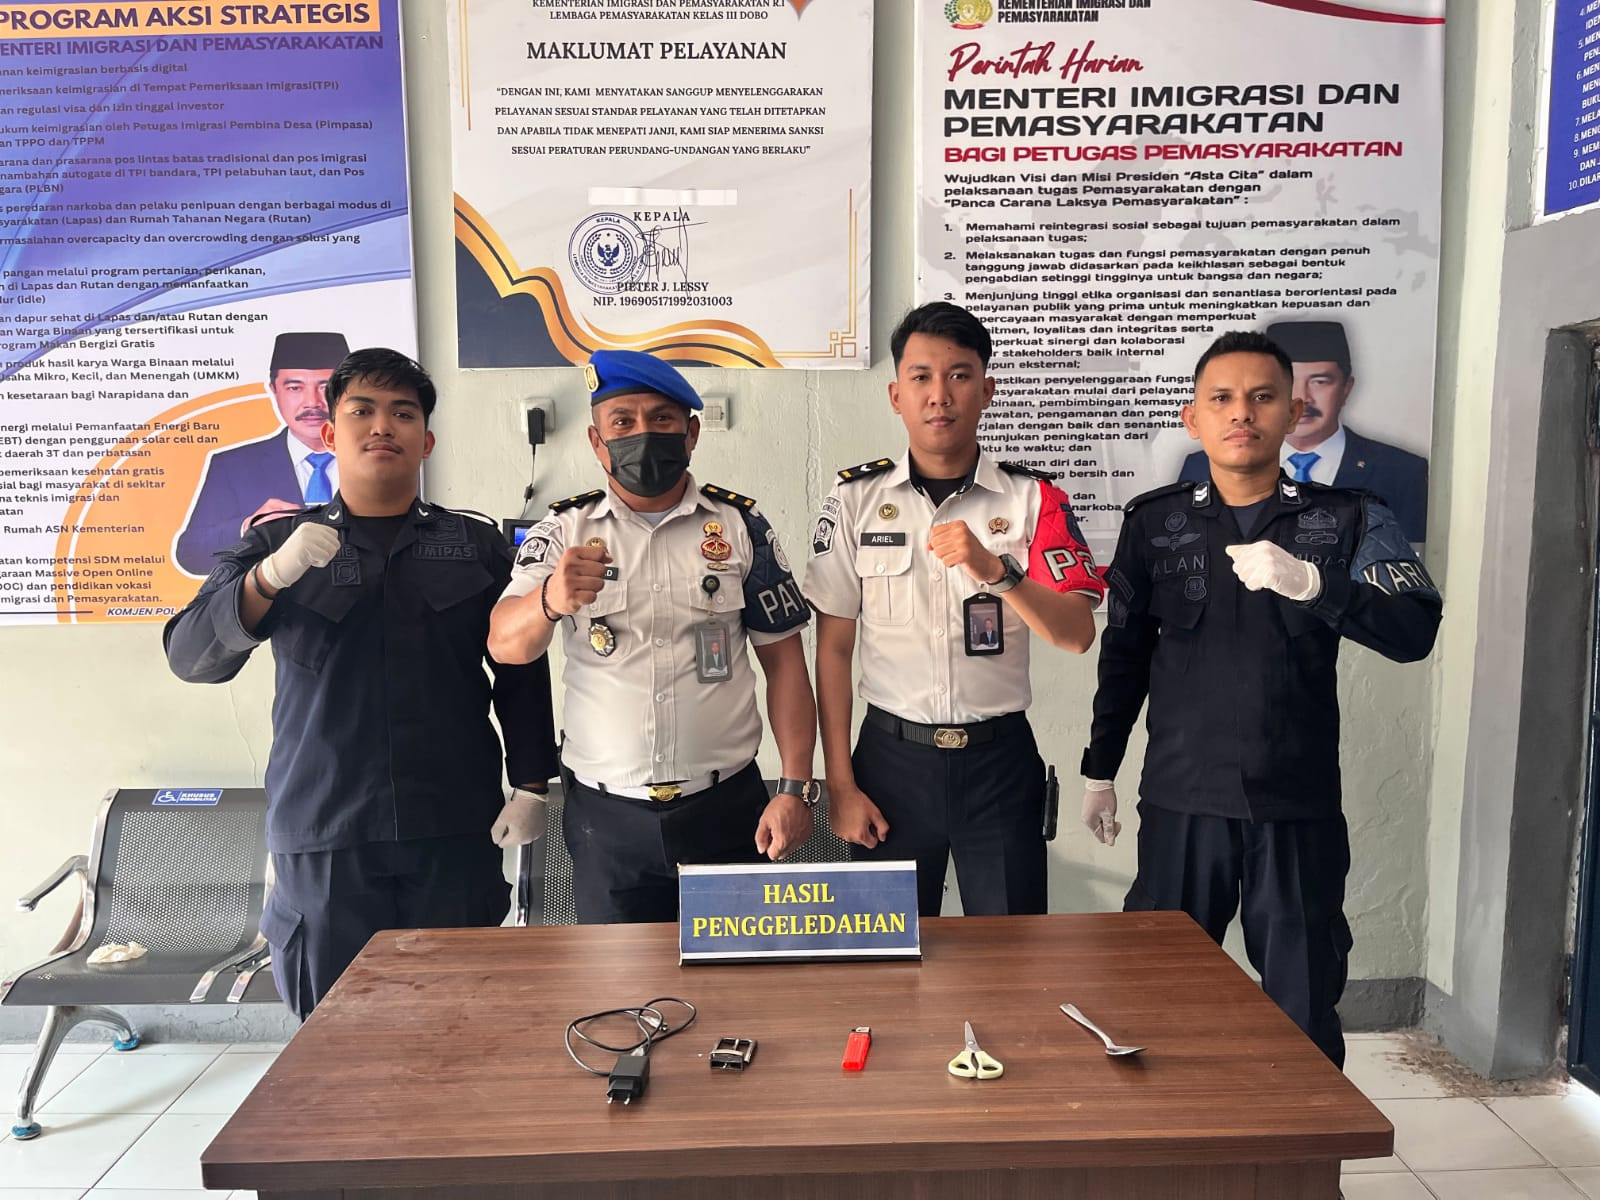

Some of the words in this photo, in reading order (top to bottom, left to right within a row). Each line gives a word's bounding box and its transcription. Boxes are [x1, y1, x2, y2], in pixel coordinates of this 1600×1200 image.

[998, 0, 1072, 9] KEMENTERIAN
[1076, 0, 1125, 9] IMIGRASI
[1129, 0, 1151, 8] DAN
[0, 8, 138, 30] PROGRAM
[145, 6, 212, 26] AKSI
[220, 3, 370, 25] STRATEGIS
[550, 11, 597, 19] LEMBAGA
[600, 11, 690, 19] PEMASYARAKATAN
[693, 11, 723, 19] KELAS
[726, 11, 737, 19] III
[740, 11, 768, 19] DOBO
[997, 10, 1099, 23] PEMASYARAKATAN
[67, 39, 150, 55] IMIGRASI
[156, 38, 197, 53] DAN
[203, 35, 384, 52] PEMASYARAKATAN
[527, 42, 654, 59] MAKLUMAT
[660, 42, 787, 59] PELAYANAN
[947, 41, 1055, 82] Perintah
[1060, 40, 1144, 84] Harian
[26, 65, 97, 77] keimigrasian
[101, 63, 148, 73] berbasis
[152, 63, 187, 74] digital
[545, 88, 562, 96] INI,
[565, 88, 590, 96] KAMI
[596, 88, 663, 96] MENYATAKAN
[666, 88, 713, 96] SANGGUP
[716, 87, 823, 96] MENYELENGGARAKAN
[944, 87, 1116, 109] MENTERI
[1131, 85, 1304, 106] IMIGRASI
[1318, 83, 1399, 104] DAN
[495, 107, 553, 115] PELAYANAN
[554, 107, 590, 115] SESUAI
[591, 107, 638, 115] STANDAR
[640, 107, 698, 115] PELAYANAN
[699, 107, 727, 115] YANG
[729, 107, 761, 115] TELAH
[764, 107, 826, 115] DITETAPKAN
[944, 112, 1323, 136] PEMASYARAKATAN
[520, 127, 561, 135] APABILA
[563, 127, 594, 135] TIDAK
[596, 127, 646, 135] MENEPATI
[649, 127, 677, 136] JANJI,
[680, 127, 705, 135] KAMI
[708, 127, 730, 135] SIAP
[788, 126, 824, 134] SANKSI
[512, 146, 546, 154] SESUAI
[548, 146, 606, 154] PERATURAN
[609, 146, 730, 154] PERUNDANG-UNDANGAN
[732, 146, 760, 154] YANG
[945, 147, 1005, 162] BAGI
[1014, 146, 1137, 161] PETUGAS
[1145, 142, 1402, 159] PEMASYARAKATAN
[1580, 158, 1596, 171] DAN
[944, 173, 1016, 184] Wujudkan
[1020, 173, 1046, 182] Visi
[1050, 172, 1077, 182] dan
[1082, 172, 1111, 182] Misi
[1116, 171, 1179, 181] Presiden
[1269, 169, 1313, 179] dalam
[944, 186, 1033, 197] pelaksanaan
[1038, 185, 1078, 196] tugas
[1082, 184, 1204, 195] Pemasyarakatan
[1208, 183, 1261, 194] dengan
[1000, 198, 1051, 207] Carana
[1057, 197, 1107, 208] Laksya
[633, 211, 691, 221] KEPALA
[944, 223, 953, 231] 1.
[966, 222, 1035, 231] Memahami
[1039, 222, 1108, 232] reintegrasi
[1112, 221, 1149, 229] sosial
[1152, 220, 1202, 230] sebagai
[1205, 220, 1247, 230] tujuan
[1250, 218, 1358, 229] pemasyarakatan
[1361, 218, 1400, 226] dalam
[965, 234, 1045, 244] pelaksanaan
[1048, 234, 1088, 244] tugas;
[617, 282, 659, 292] PIETER
[661, 282, 670, 292] J.
[673, 282, 709, 292] LESSY
[593, 296, 616, 306] NIP.
[620, 296, 733, 306] 196905171992031003
[1048, 337, 1089, 347] sinergi
[1121, 336, 1185, 344] kolaborasi
[5, 359, 45, 370] produk
[48, 358, 75, 367] hasil
[77, 358, 109, 369] karya
[110, 358, 147, 368] Warga
[149, 357, 189, 366] Binaan
[192, 357, 234, 366] melalui
[34, 372, 69, 383] Mikro,
[71, 372, 103, 383] Kecil,
[105, 372, 127, 380] dan
[130, 371, 190, 382] Menengah
[193, 371, 239, 382] (UMKM)
[7, 391, 68, 400] kesetaraan
[71, 390, 95, 401] bagi
[98, 390, 164, 401] Narapidana
[167, 389, 189, 398] dan
[31, 422, 72, 431] melalui
[76, 422, 151, 431] Pemanfaatan
[154, 421, 190, 432] Energi
[193, 421, 219, 430] Baru
[25, 436, 66, 447] dengan
[69, 437, 139, 446] penggunaan
[142, 435, 170, 444] solar
[173, 435, 194, 443] cell
[197, 434, 218, 443] dan
[4, 449, 44, 458] daerah
[46, 449, 60, 457] 3T
[62, 448, 84, 457] dan
[86, 448, 151, 459] perbatasan
[1069, 469, 1107, 478] bersih
[1112, 469, 1134, 477] dan
[4, 524, 42, 533] Rumah
[45, 524, 69, 534] ASN
[72, 524, 144, 533] Kementerian
[871, 535, 894, 544] ARIEL
[417, 545, 473, 558] IMIPAS
[1153, 554, 1205, 577] ALAN
[107, 607, 153, 616] KOMJEN
[763, 883, 835, 904] HASIL
[693, 913, 906, 937] PENGGELEDAHAN
